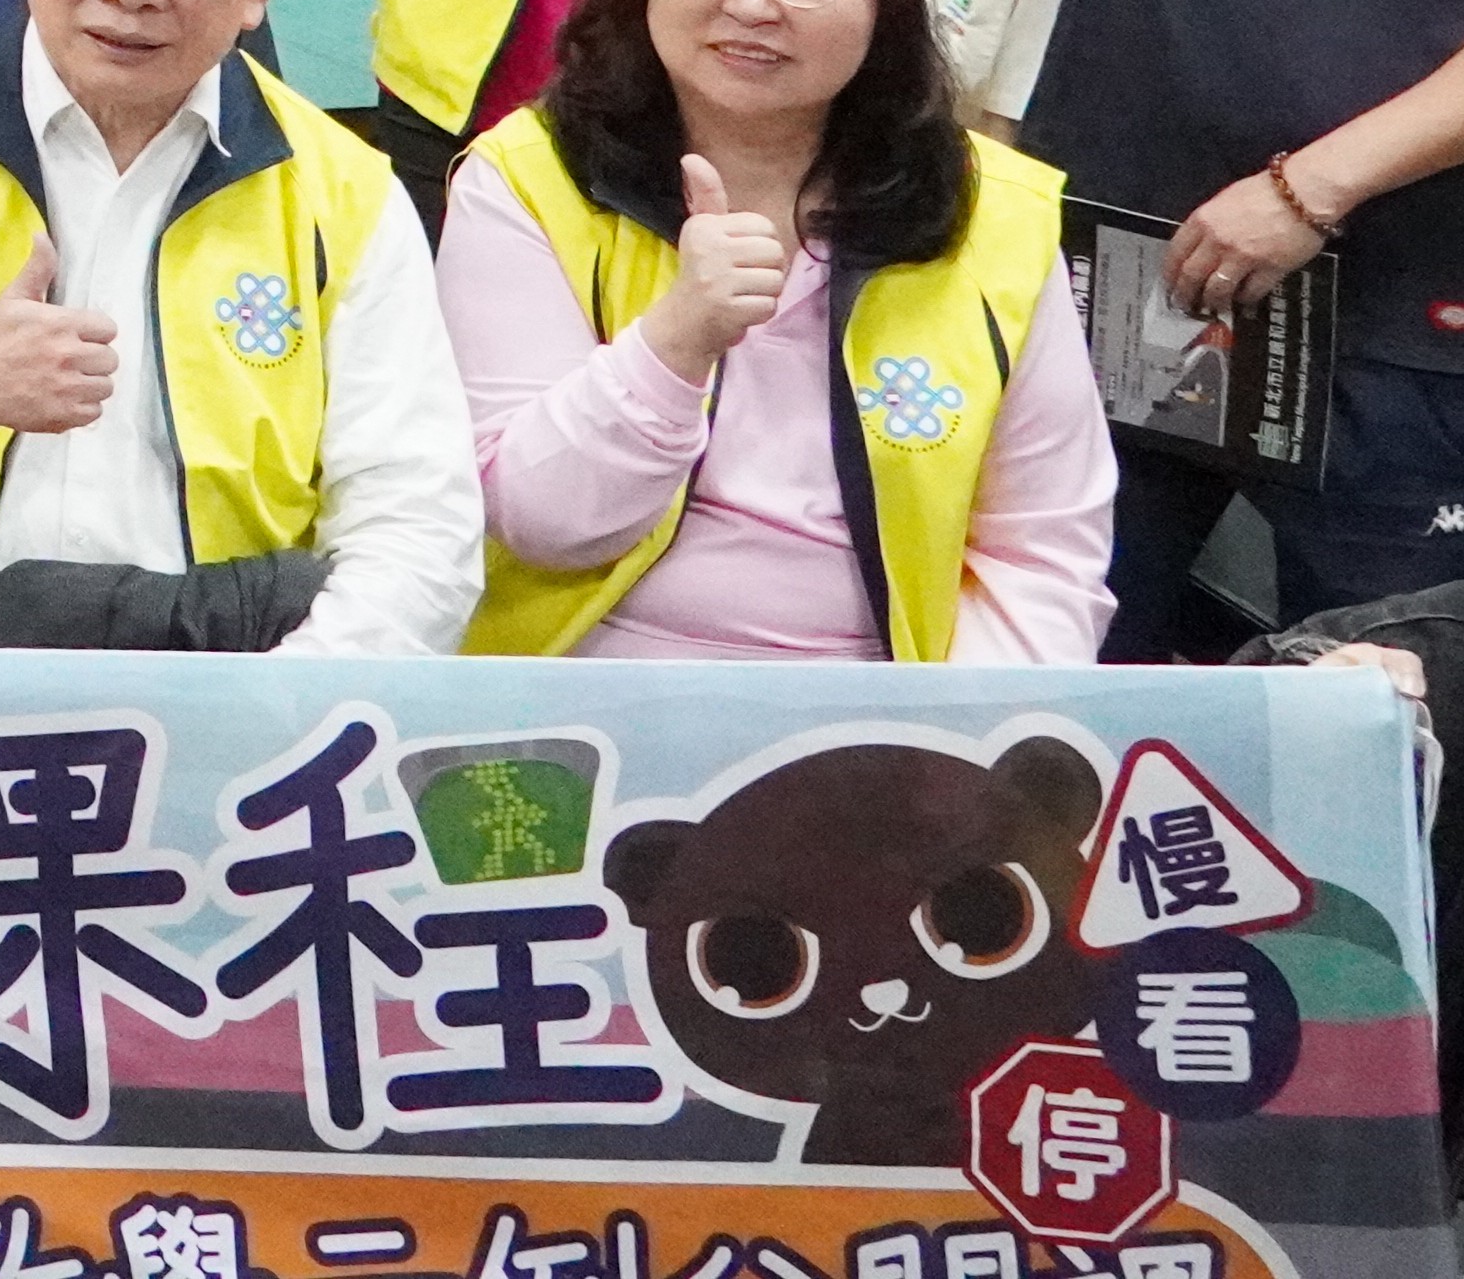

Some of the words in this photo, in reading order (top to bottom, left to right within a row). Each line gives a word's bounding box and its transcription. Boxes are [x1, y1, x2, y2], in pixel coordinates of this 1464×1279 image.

[1119, 806, 1239, 919] 慢
[1136, 971, 1252, 1083] 看
[1008, 1085, 1128, 1201] 停
